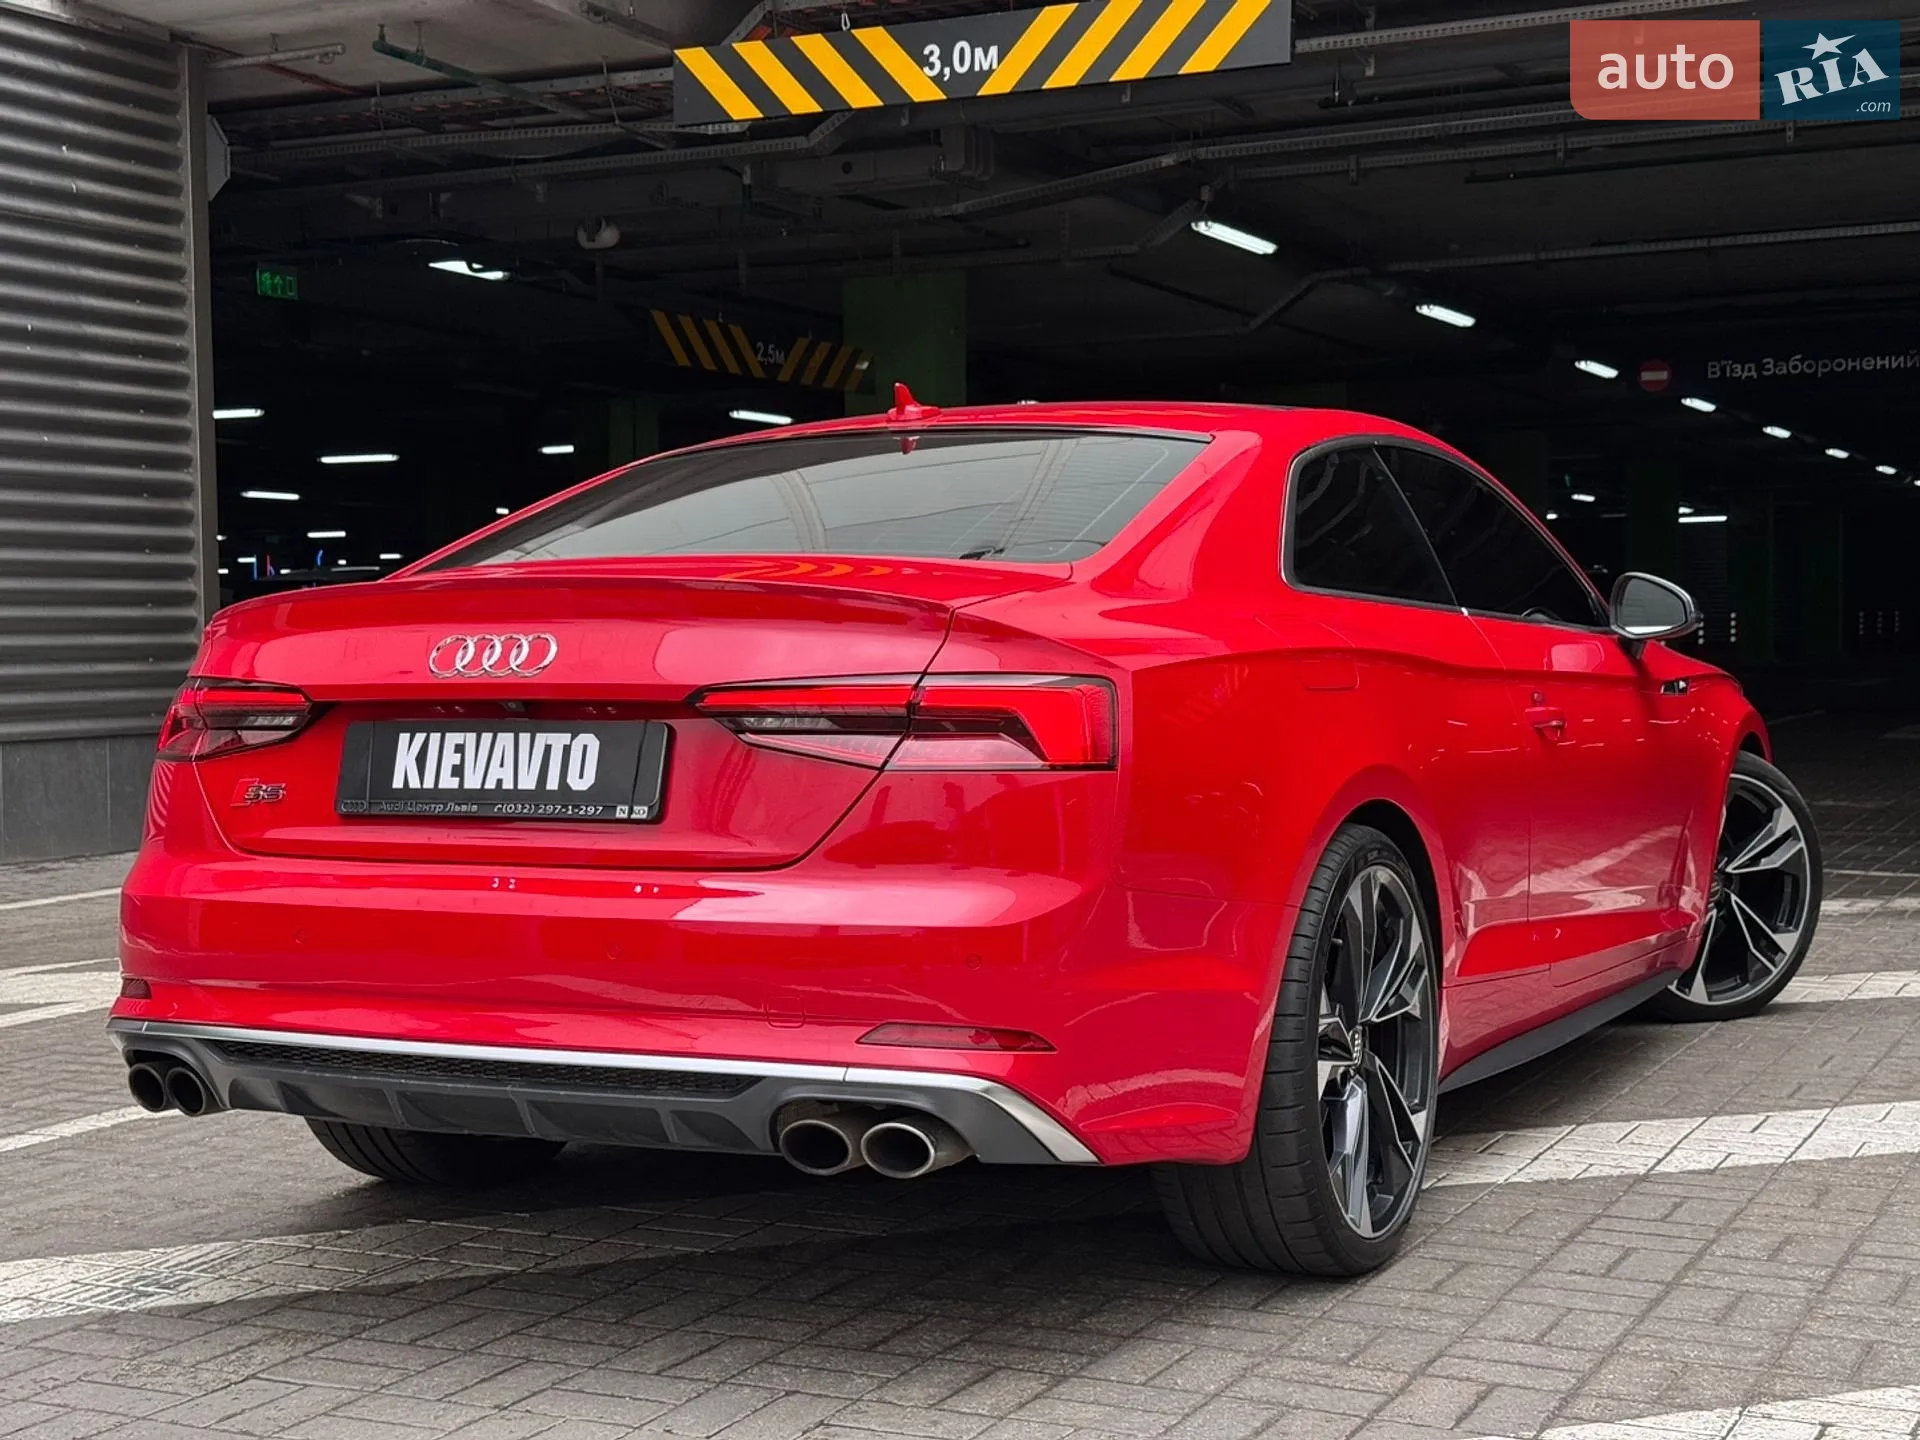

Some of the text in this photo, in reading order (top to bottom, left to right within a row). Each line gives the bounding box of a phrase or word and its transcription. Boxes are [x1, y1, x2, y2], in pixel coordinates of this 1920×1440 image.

[923, 40, 998, 82] 3,0м
[1761, 350, 1920, 378] Заборонений
[392, 732, 600, 791] KIEVAVTO
[243, 782, 287, 803] S5
[502, 804, 534, 814] (032)
[537, 804, 604, 815] 297-1-297
